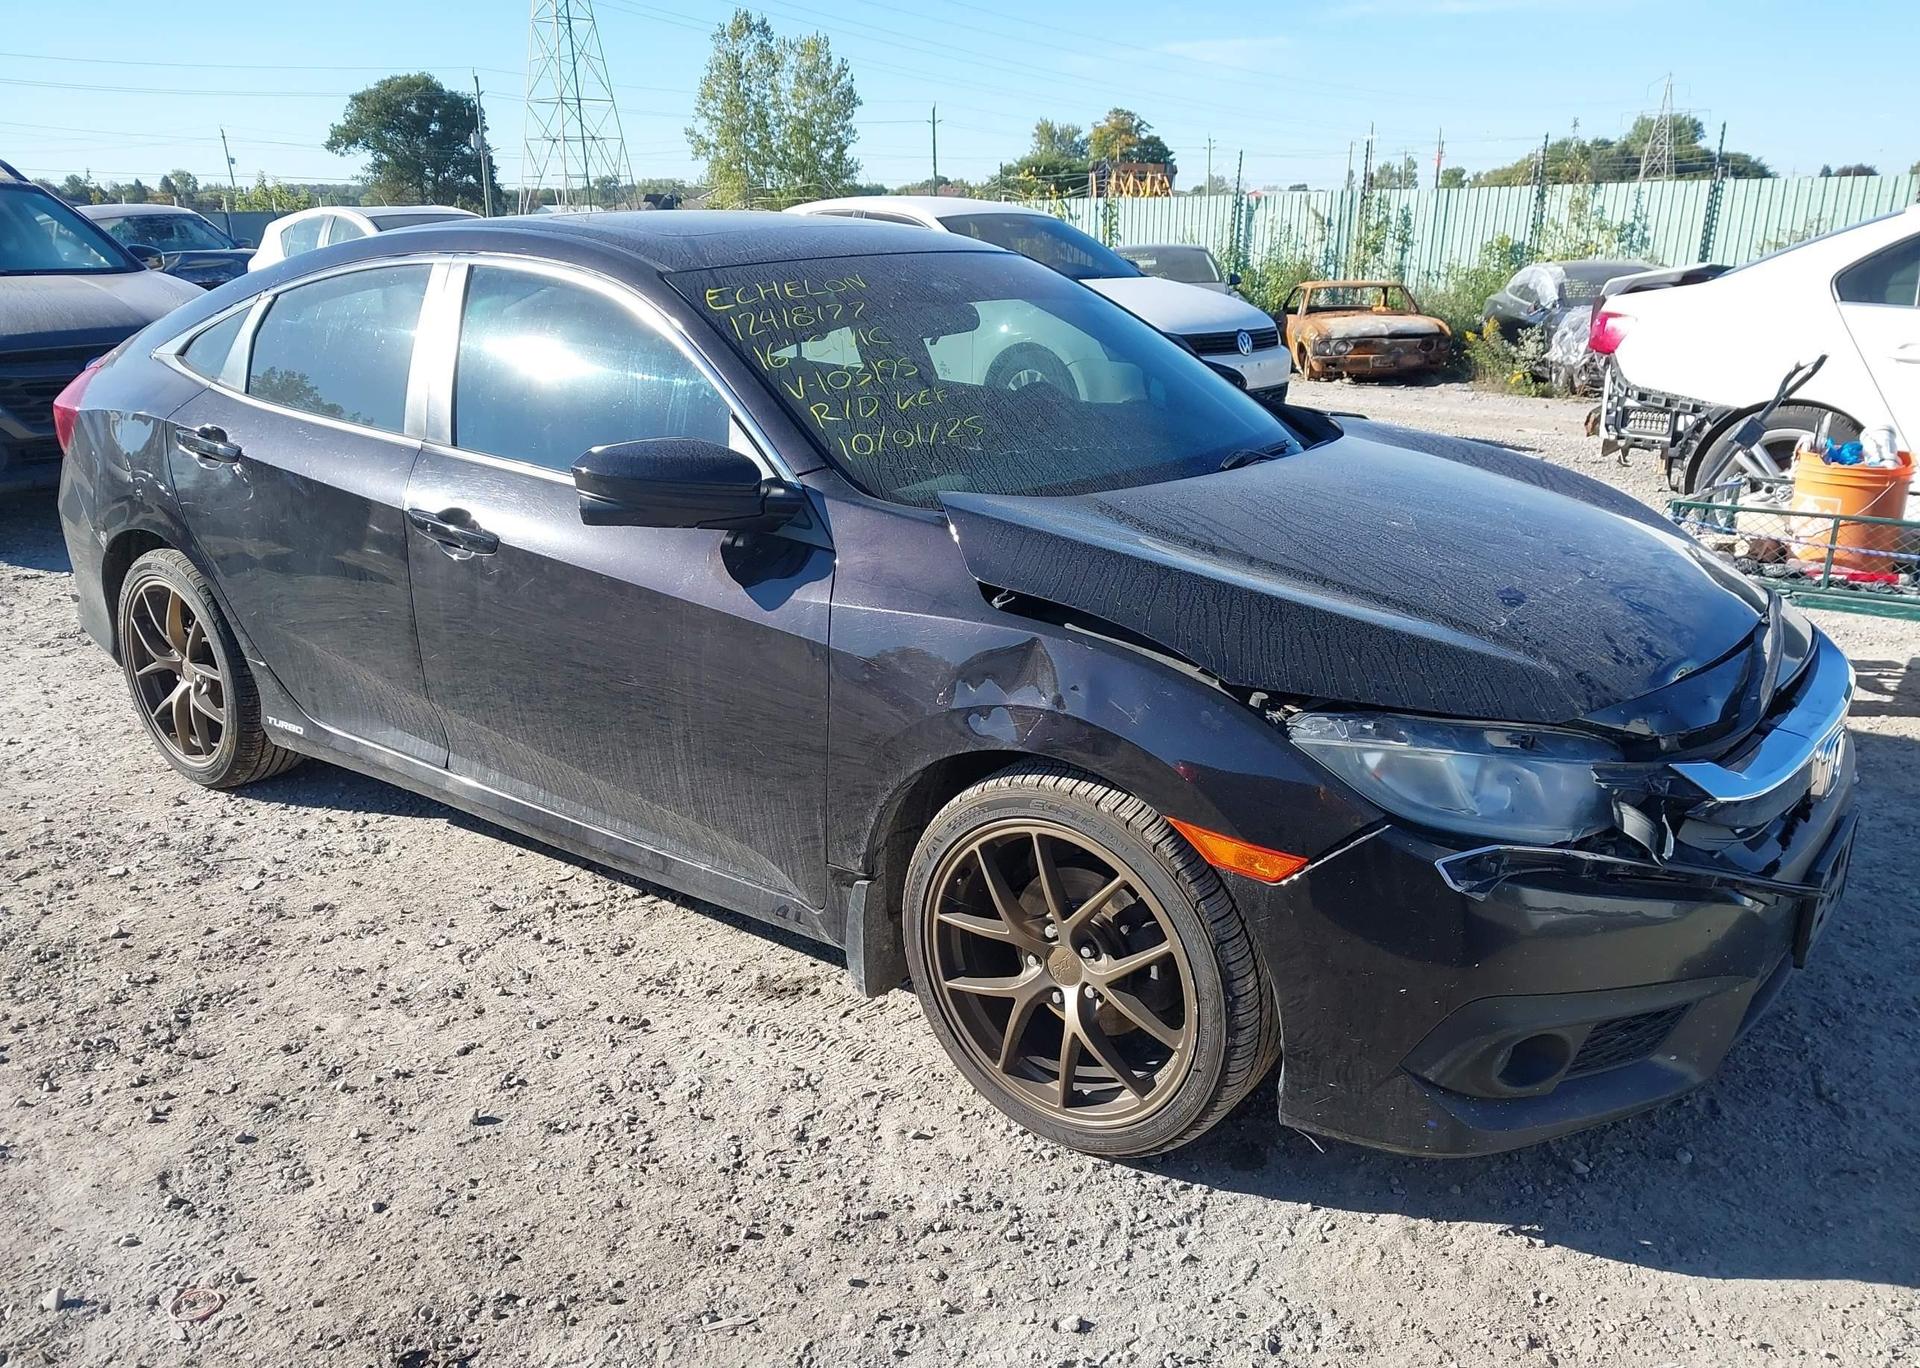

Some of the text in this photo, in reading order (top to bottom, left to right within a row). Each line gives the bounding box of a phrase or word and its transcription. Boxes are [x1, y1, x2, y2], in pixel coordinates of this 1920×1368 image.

[706, 274, 866, 310] ECHELON
[730, 302, 865, 341] 12418177
[838, 415, 984, 460] 10/01/25
[266, 715, 304, 735] TURBO
